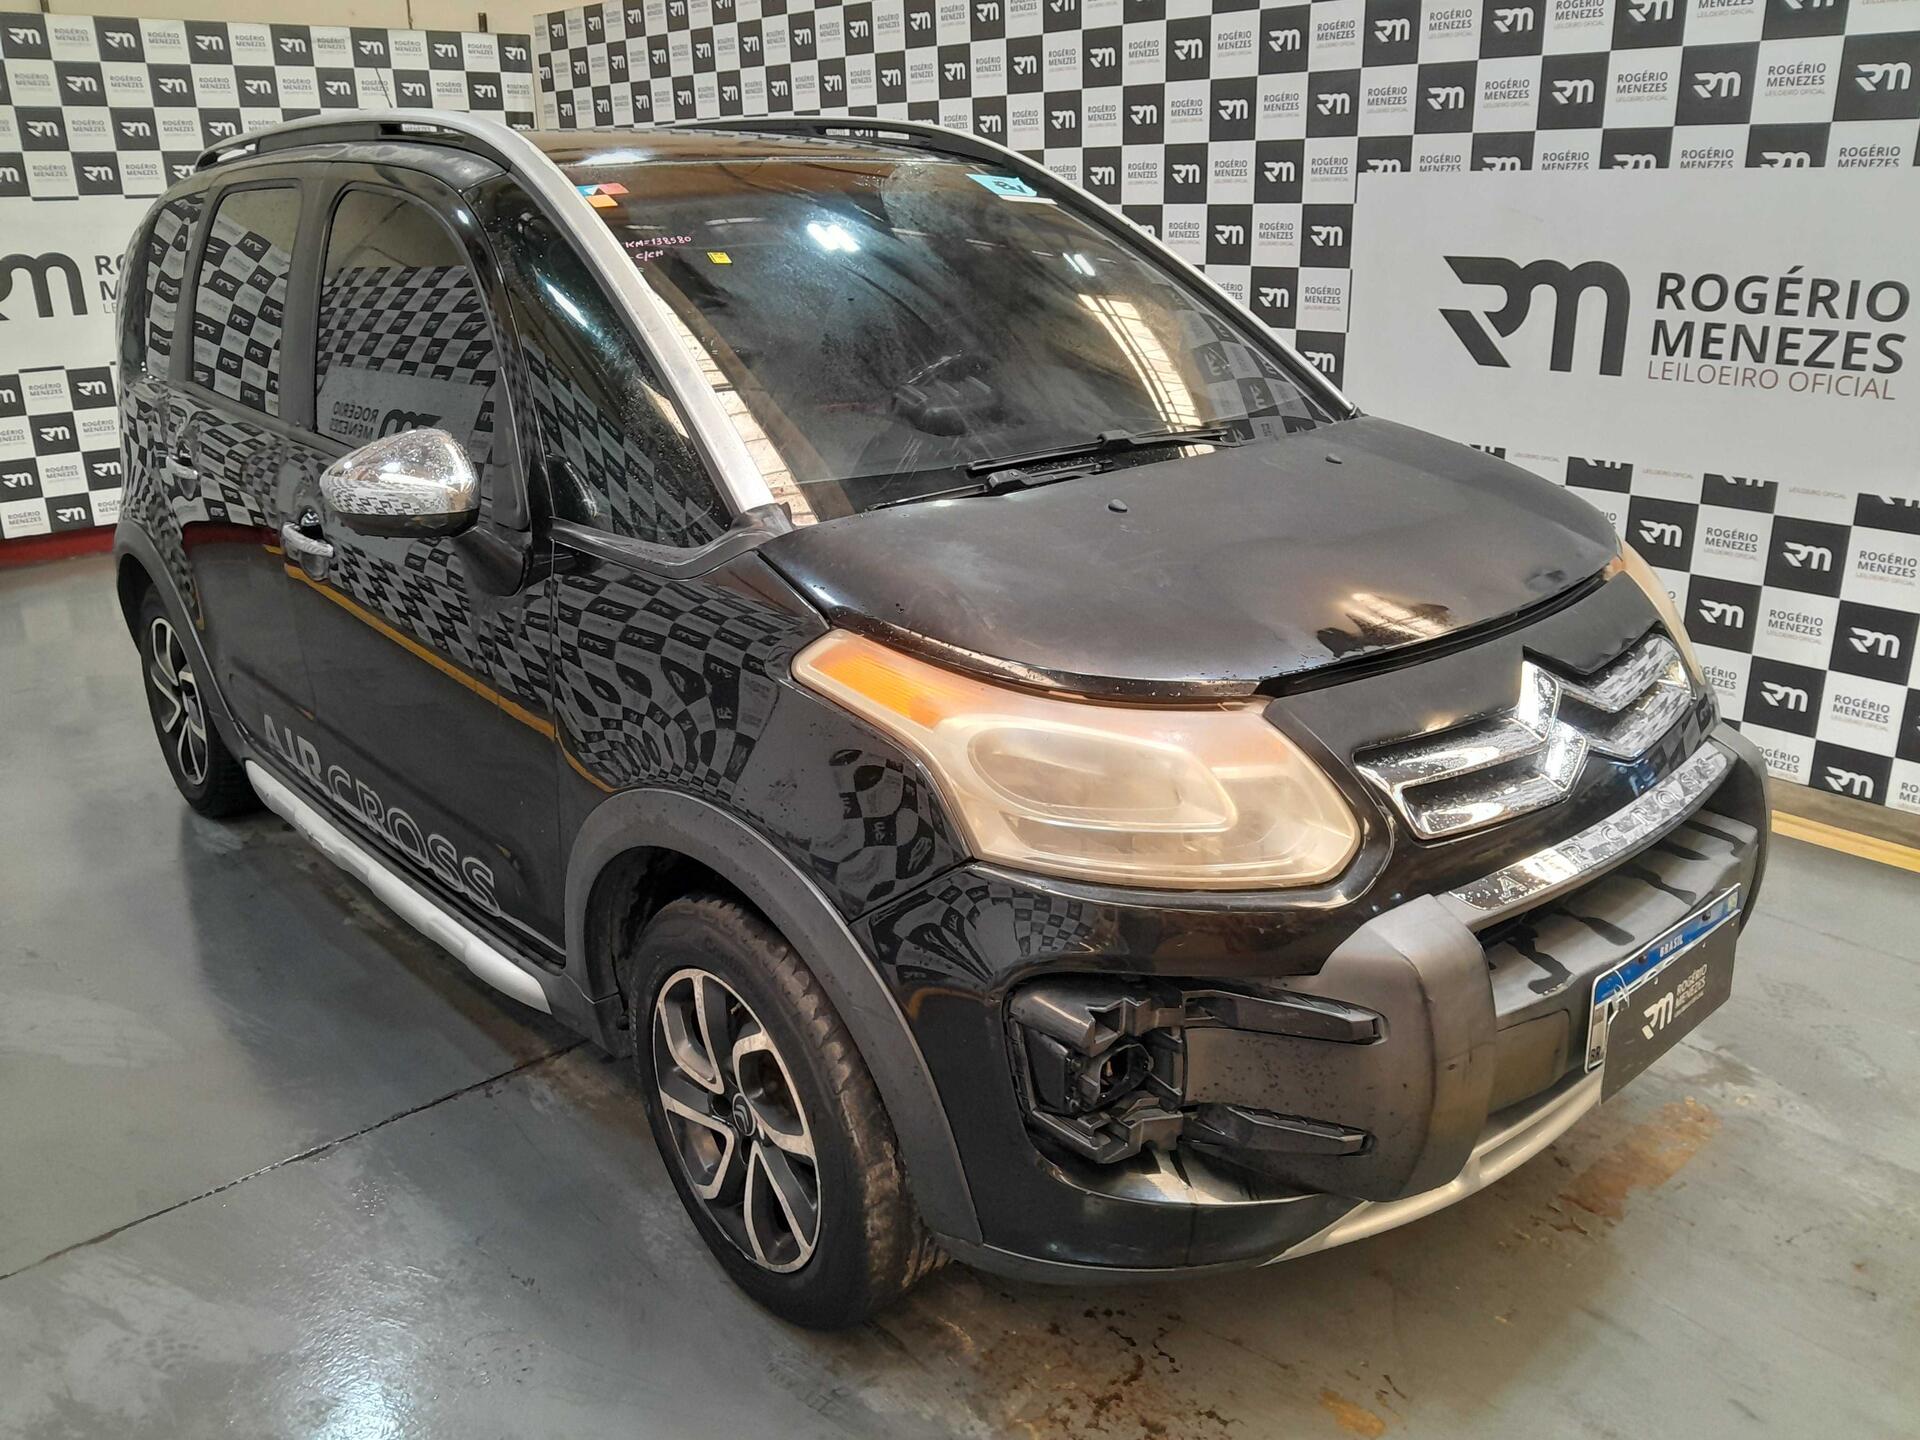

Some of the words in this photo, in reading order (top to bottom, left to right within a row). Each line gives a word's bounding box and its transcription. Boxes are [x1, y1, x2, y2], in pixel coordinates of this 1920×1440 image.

[1429, 8, 1472, 22] ROGÉRIO
[1555, 8, 1604, 21] MENEZES
[1317, 20, 1355, 32] ROGÉRIO
[1429, 19, 1472, 32] MENEZES
[1218, 30, 1252, 40] ROGÉRIO
[1317, 29, 1355, 42] MENEZES
[1218, 40, 1252, 50] MENEZES
[1128, 48, 1159, 59] MENEZES
[1048, 56, 1076, 67] MENEZES
[1768, 61, 1826, 76] ROGÉRIO
[1618, 70, 1668, 83] ROGÉRIO
[1766, 75, 1825, 88] MENEZES
[1485, 79, 1530, 90] ROGÉRIO
[1616, 82, 1667, 94] MENEZES
[1263, 91, 1299, 102] ROGÉRIO
[1368, 86, 1407, 97] ROGÉRIO
[1484, 89, 1530, 101] MENEZES
[1264, 102, 1299, 113] MENEZES
[1367, 96, 1407, 107] MENEZES
[1088, 112, 1116, 122] MENEZES
[1171, 107, 1203, 117] MENEZES
[1012, 117, 1038, 126] MENEZES
[1542, 150, 1589, 162] ROGÉRIO
[1681, 146, 1734, 158] ROGÉRIO
[1839, 143, 1900, 157] ROGÉRIO
[1214, 159, 1248, 168] ROGÉRIO
[1311, 157, 1348, 166] ROGÉRIO
[1420, 154, 1461, 164] ROGÉRIO
[1128, 162, 1158, 170] ROGÉRIO
[1311, 166, 1348, 175] MENEZES
[1128, 171, 1158, 179] MENEZES
[1214, 168, 1248, 177] MENEZES
[1168, 222, 1200, 230] ROGÉRIO
[1259, 221, 1294, 230] ROGÉRIO
[1259, 232, 1294, 240] MENEZES
[1305, 285, 1341, 295] ROGÉRIO
[1656, 266, 1910, 322] ROGÉRIO
[1304, 295, 1340, 304] MENEZES
[1650, 319, 1906, 374] MENEZES
[1648, 361, 1778, 390] LEILOEIRO
[1788, 372, 1896, 400] OFICIAL
[1706, 527, 1758, 543] ROGÉRIO
[1705, 537, 1757, 553] MENEZES
[1859, 550, 1917, 568] ROGÉRIO
[1858, 560, 1916, 578] MENEZES
[1769, 609, 1823, 626] ROGÉRIO
[1768, 619, 1822, 637] MENEZES
[1834, 694, 1889, 714] ROGÉRIO
[1832, 704, 1888, 724] MENEZES
[1766, 758, 1799, 773] NEZES
